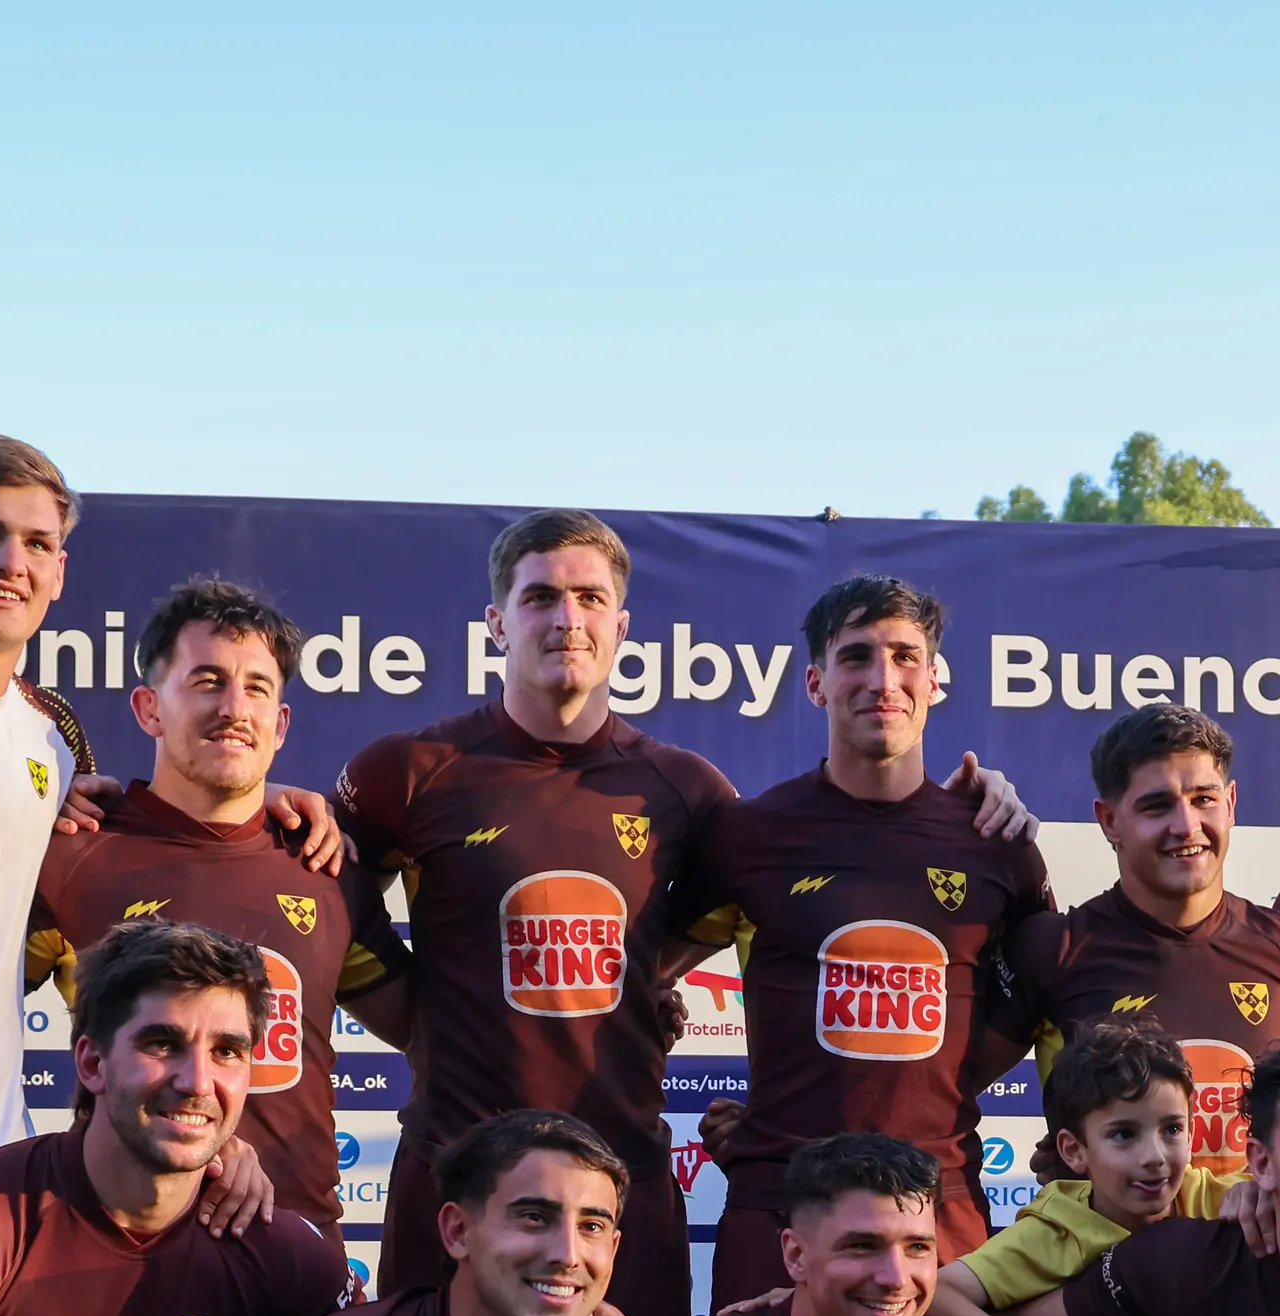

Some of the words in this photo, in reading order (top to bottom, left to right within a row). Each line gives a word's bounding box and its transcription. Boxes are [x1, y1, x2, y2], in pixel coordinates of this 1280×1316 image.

[301, 615, 426, 695] de
[467, 621, 792, 717] Rgby
[507, 919, 621, 946] BURGER
[508, 947, 622, 986] KING
[824, 963, 943, 994] BURGER
[822, 989, 942, 1032] KING
[684, 1023, 748, 1036] TotalEn
